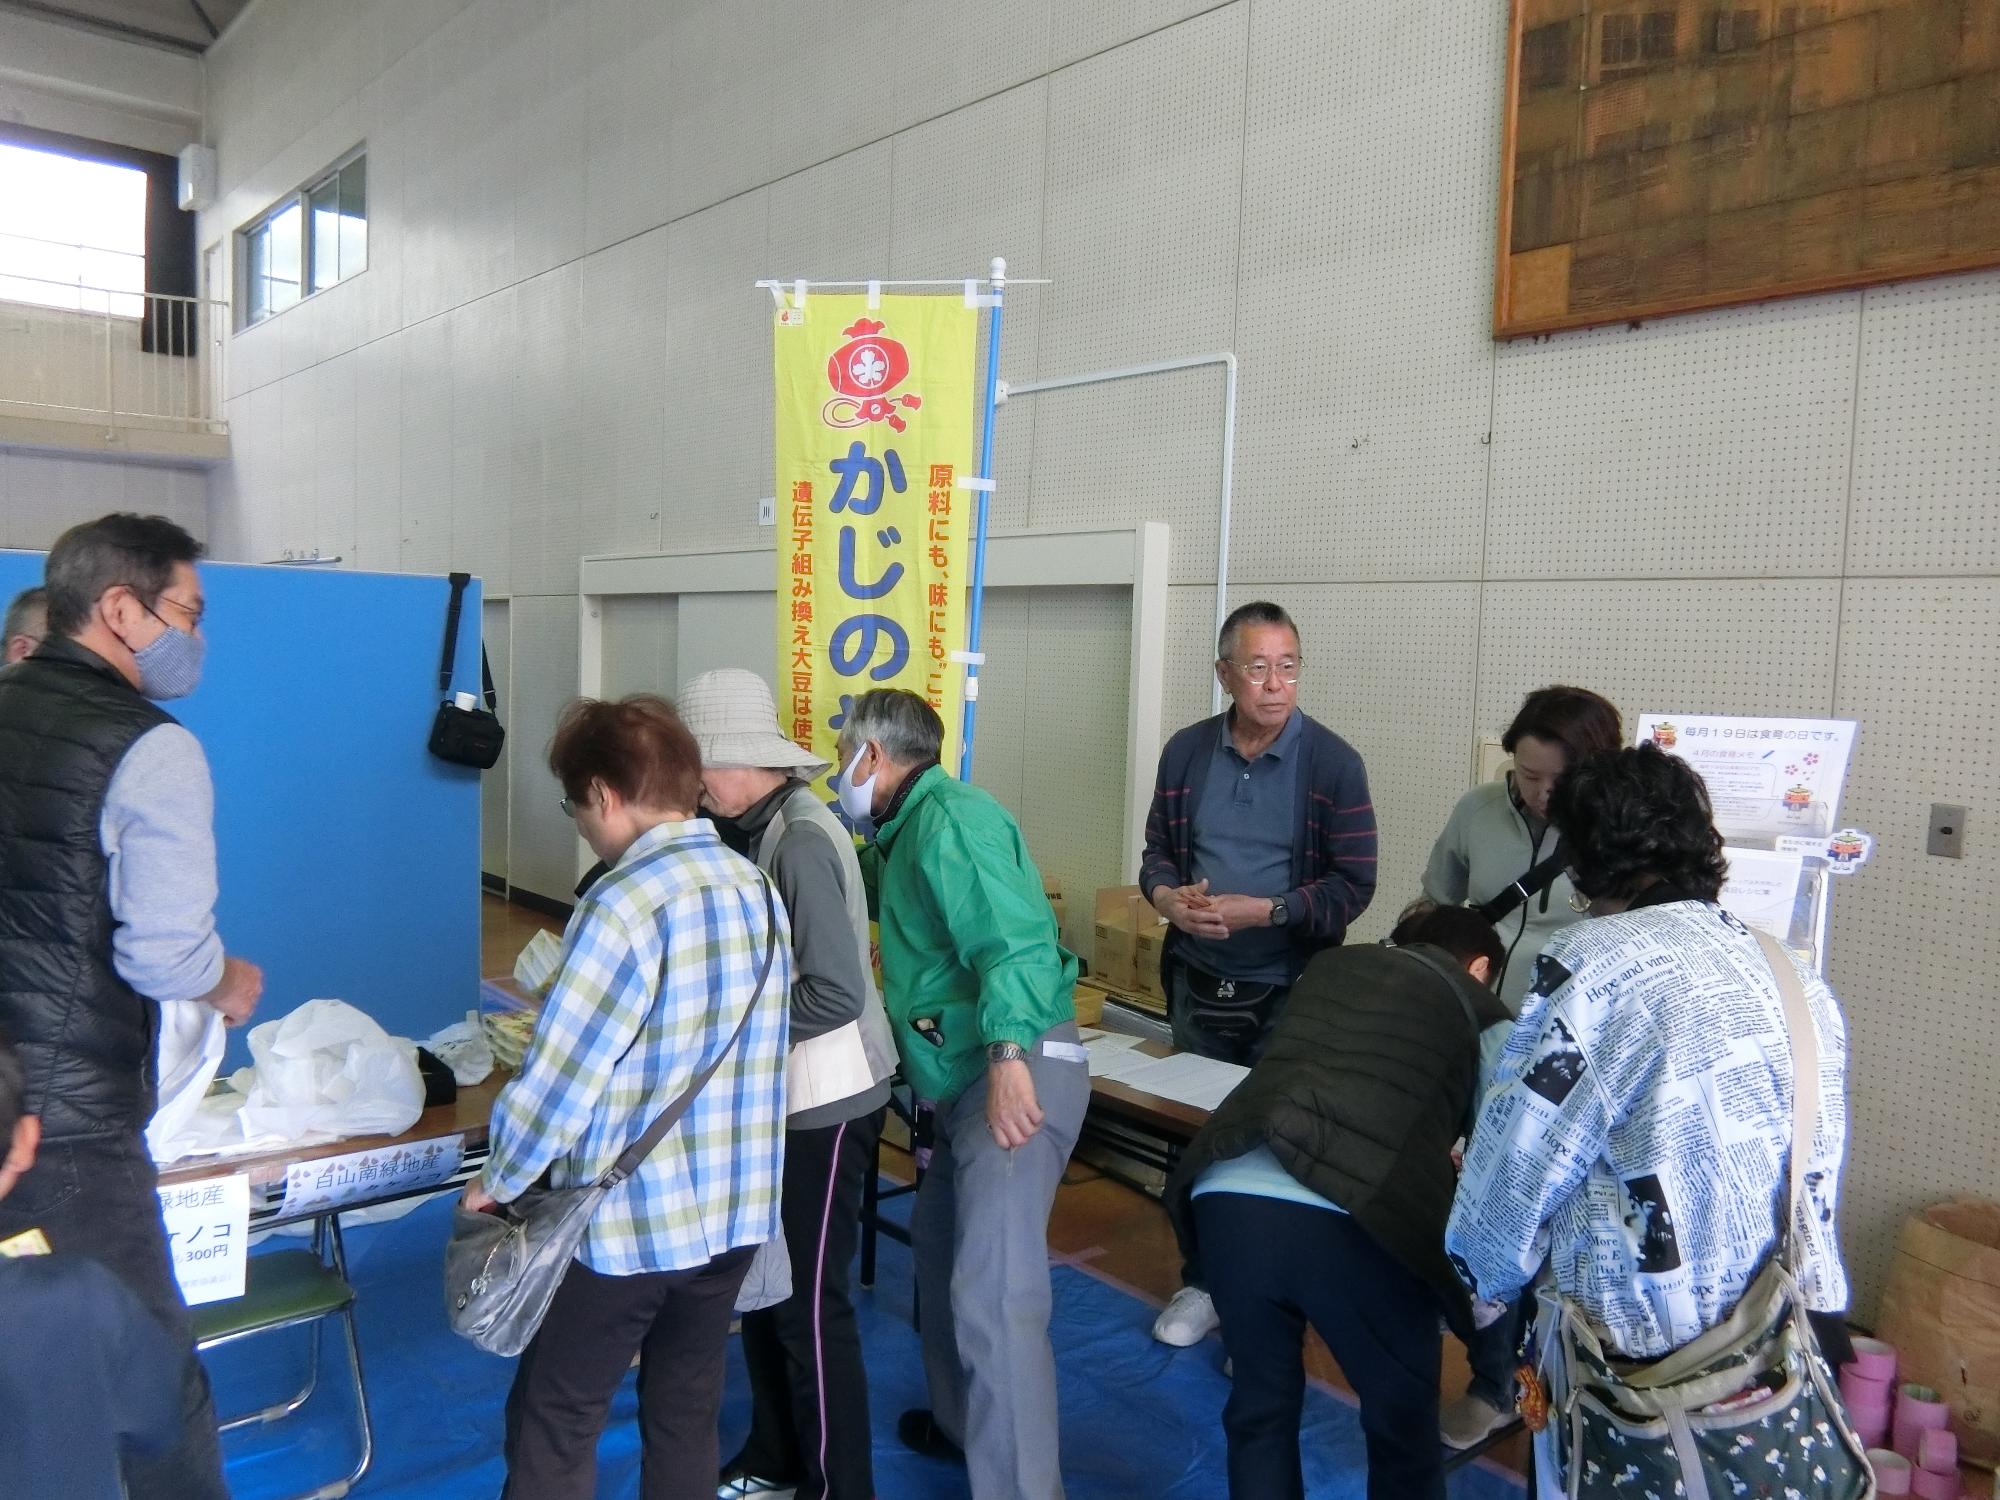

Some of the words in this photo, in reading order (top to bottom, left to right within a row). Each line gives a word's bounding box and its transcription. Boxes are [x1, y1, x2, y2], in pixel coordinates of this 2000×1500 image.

[827, 440, 910, 838] かじの
[1585, 978, 1618, 1003] Hope
[1620, 960, 1645, 982] and
[1540, 1128, 1571, 1156] Hope
[186, 1243, 228, 1262] 300円
[1688, 1283, 1714, 1300] ope
